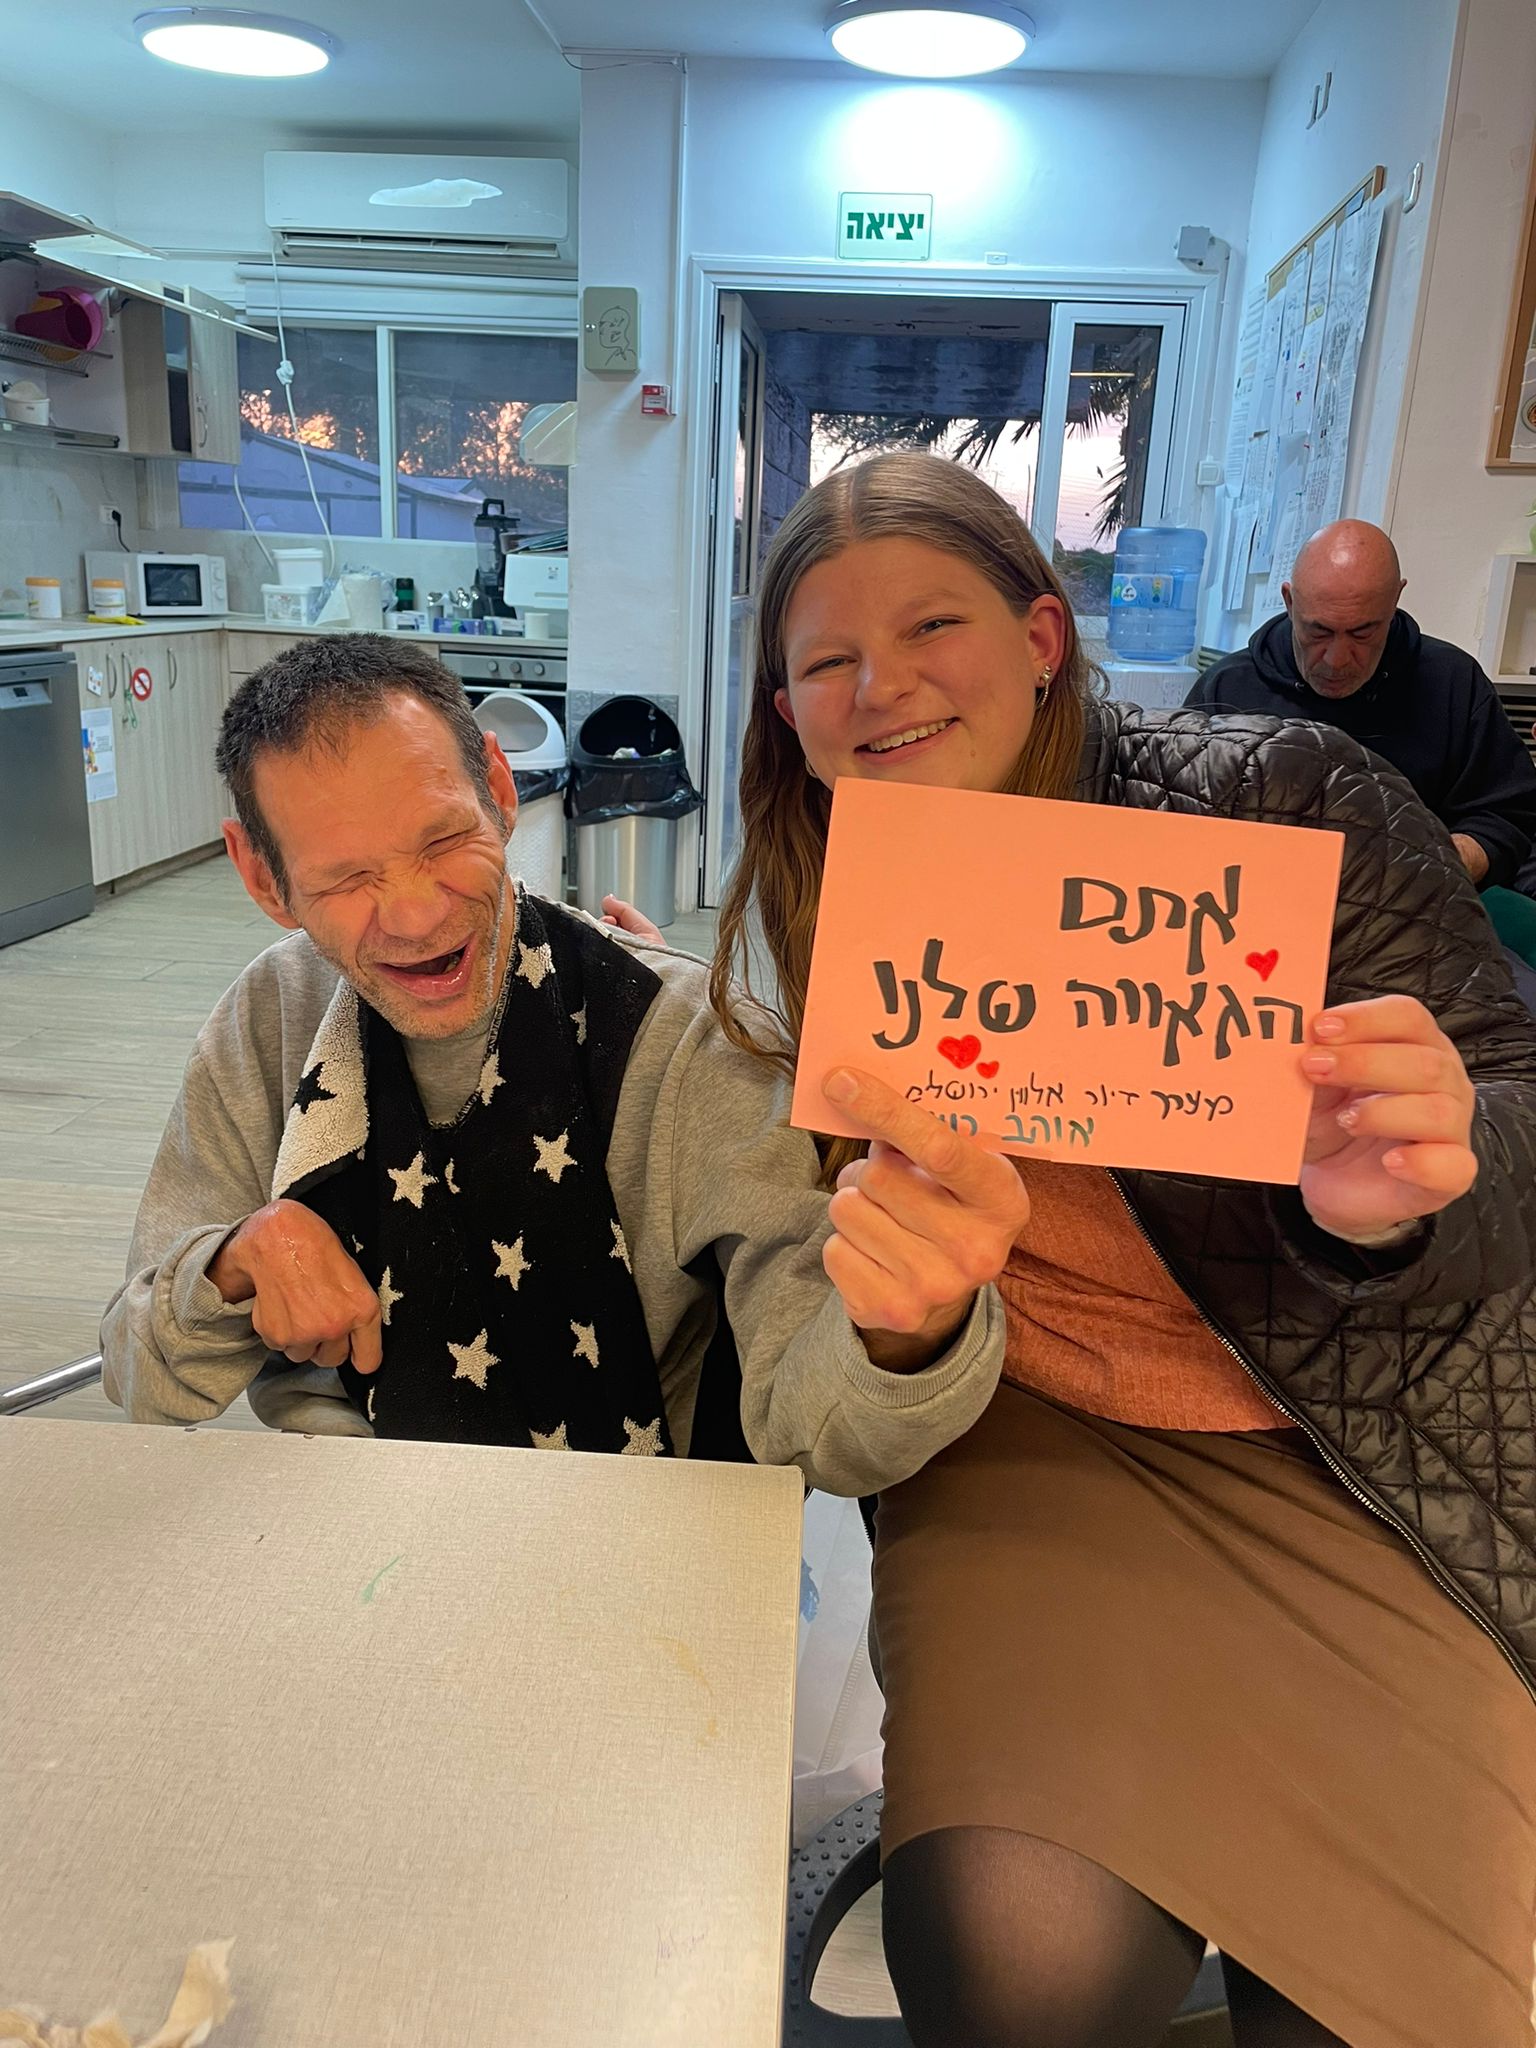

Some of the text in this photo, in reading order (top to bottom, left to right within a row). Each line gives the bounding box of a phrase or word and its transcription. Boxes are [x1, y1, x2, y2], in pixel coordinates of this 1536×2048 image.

[847, 212, 924, 240] יציאה
[1060, 865, 1241, 975] אתם
[872, 938, 1304, 1067] הגאווה שלנו
[1010, 1071, 1063, 1112] אלווין
[1085, 1084, 1140, 1106] דיור
[1001, 1114, 1094, 1147] אוהב
